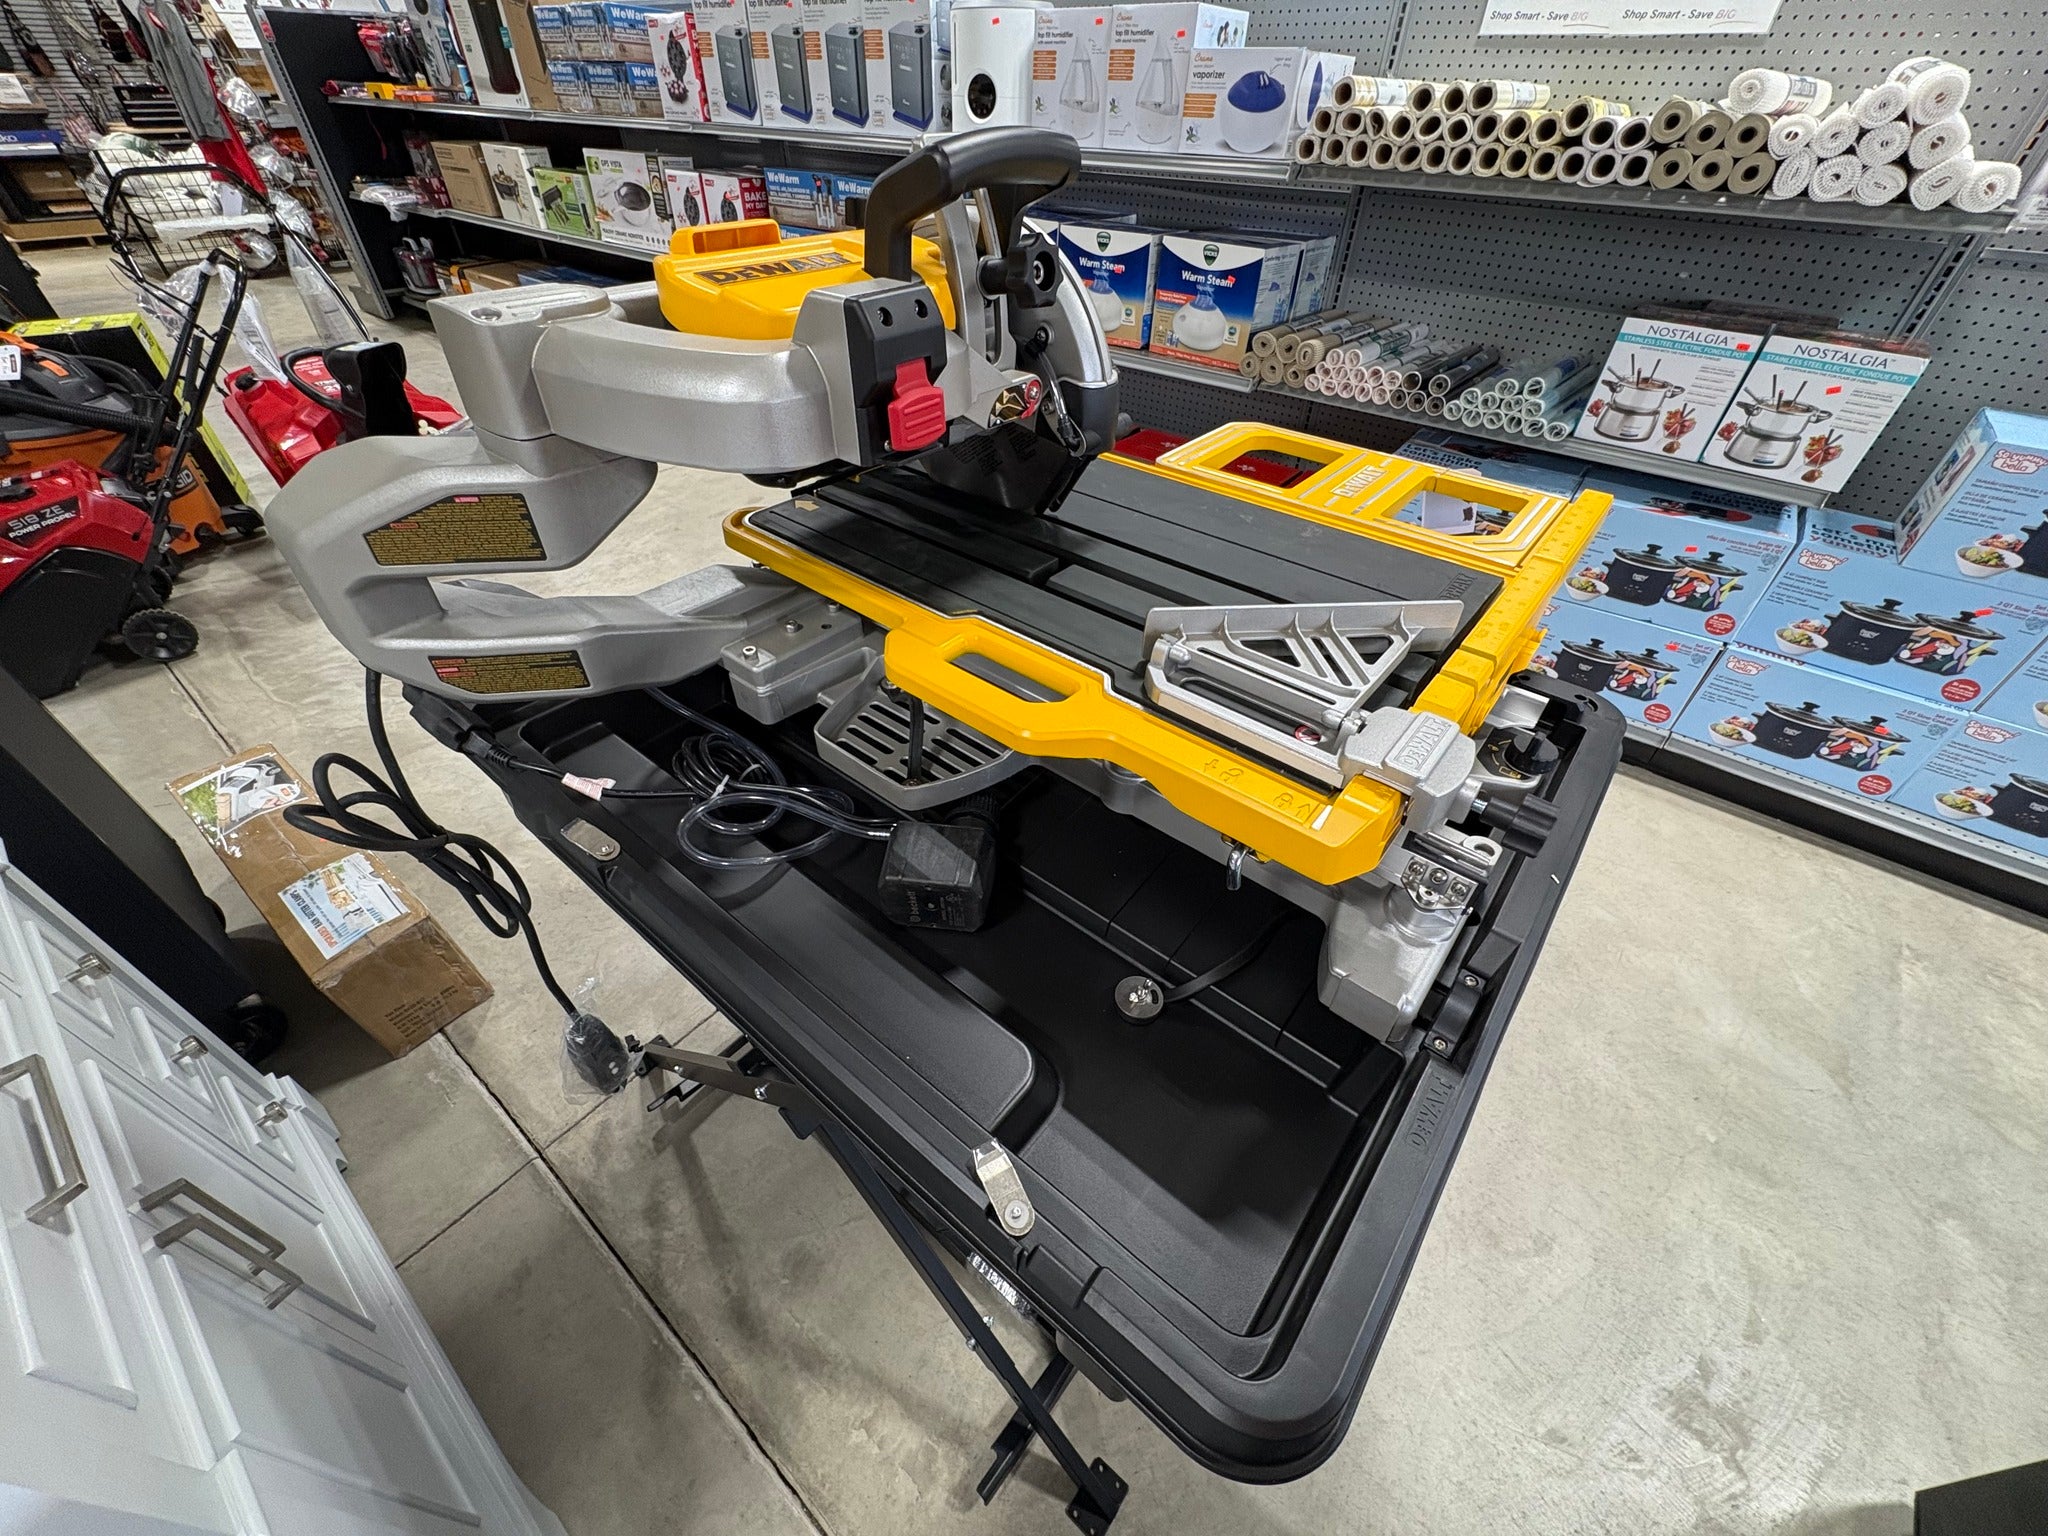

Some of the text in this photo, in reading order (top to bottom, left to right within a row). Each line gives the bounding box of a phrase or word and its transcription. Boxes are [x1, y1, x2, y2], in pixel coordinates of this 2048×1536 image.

[610, 7, 645, 20] WeWar
[1490, 11, 1512, 21] Shop
[1513, 11, 1540, 21] Smart
[1547, 11, 1569, 21] Save
[1570, 11, 1588, 21] BIG
[1622, 9, 1647, 20] Shop
[1650, 9, 1680, 20] Smart
[1688, 9, 1713, 19] Save
[1715, 9, 1737, 19] BIG
[1193, 70, 1225, 80] vaporizer
[767, 172, 799, 184] WeWarm
[838, 181, 871, 194] WeWarm
[744, 192, 767, 202] BAKE
[703, 251, 851, 284] DEWALT
[1079, 257, 1125, 272] Warm Steam
[1181, 270, 1233, 288] Warm Steam
[1647, 325, 1729, 346] NOSTALGIA
[1624, 335, 1746, 359] STAINLESS STEEL ELECTRIC FONDUE POT
[1794, 344, 1889, 369] NOSTALGIA
[1766, 354, 1908, 383] STAINLESS STEEL ELECTRIC FONDUE POT
[1402, 448, 1479, 469] something
[1406, 443, 1482, 466] Let's make
[1997, 448, 2010, 458] So
[2001, 461, 2028, 472] bella
[7, 505, 65, 530] 518 ZE
[8, 512, 76, 539] POWER PROPEL
[1810, 535, 1887, 558] yummy
[1811, 530, 1895, 555] somethi
[1812, 524, 1896, 551] Let's ma
[1801, 548, 1849, 566] So yummy!
[1805, 558, 1827, 569] bella
[1733, 664, 1753, 674] bella
[1398, 717, 1452, 769] DEWALT
[1973, 730, 1996, 741] bella
[1405, 1075, 1456, 1154] DEWALT
